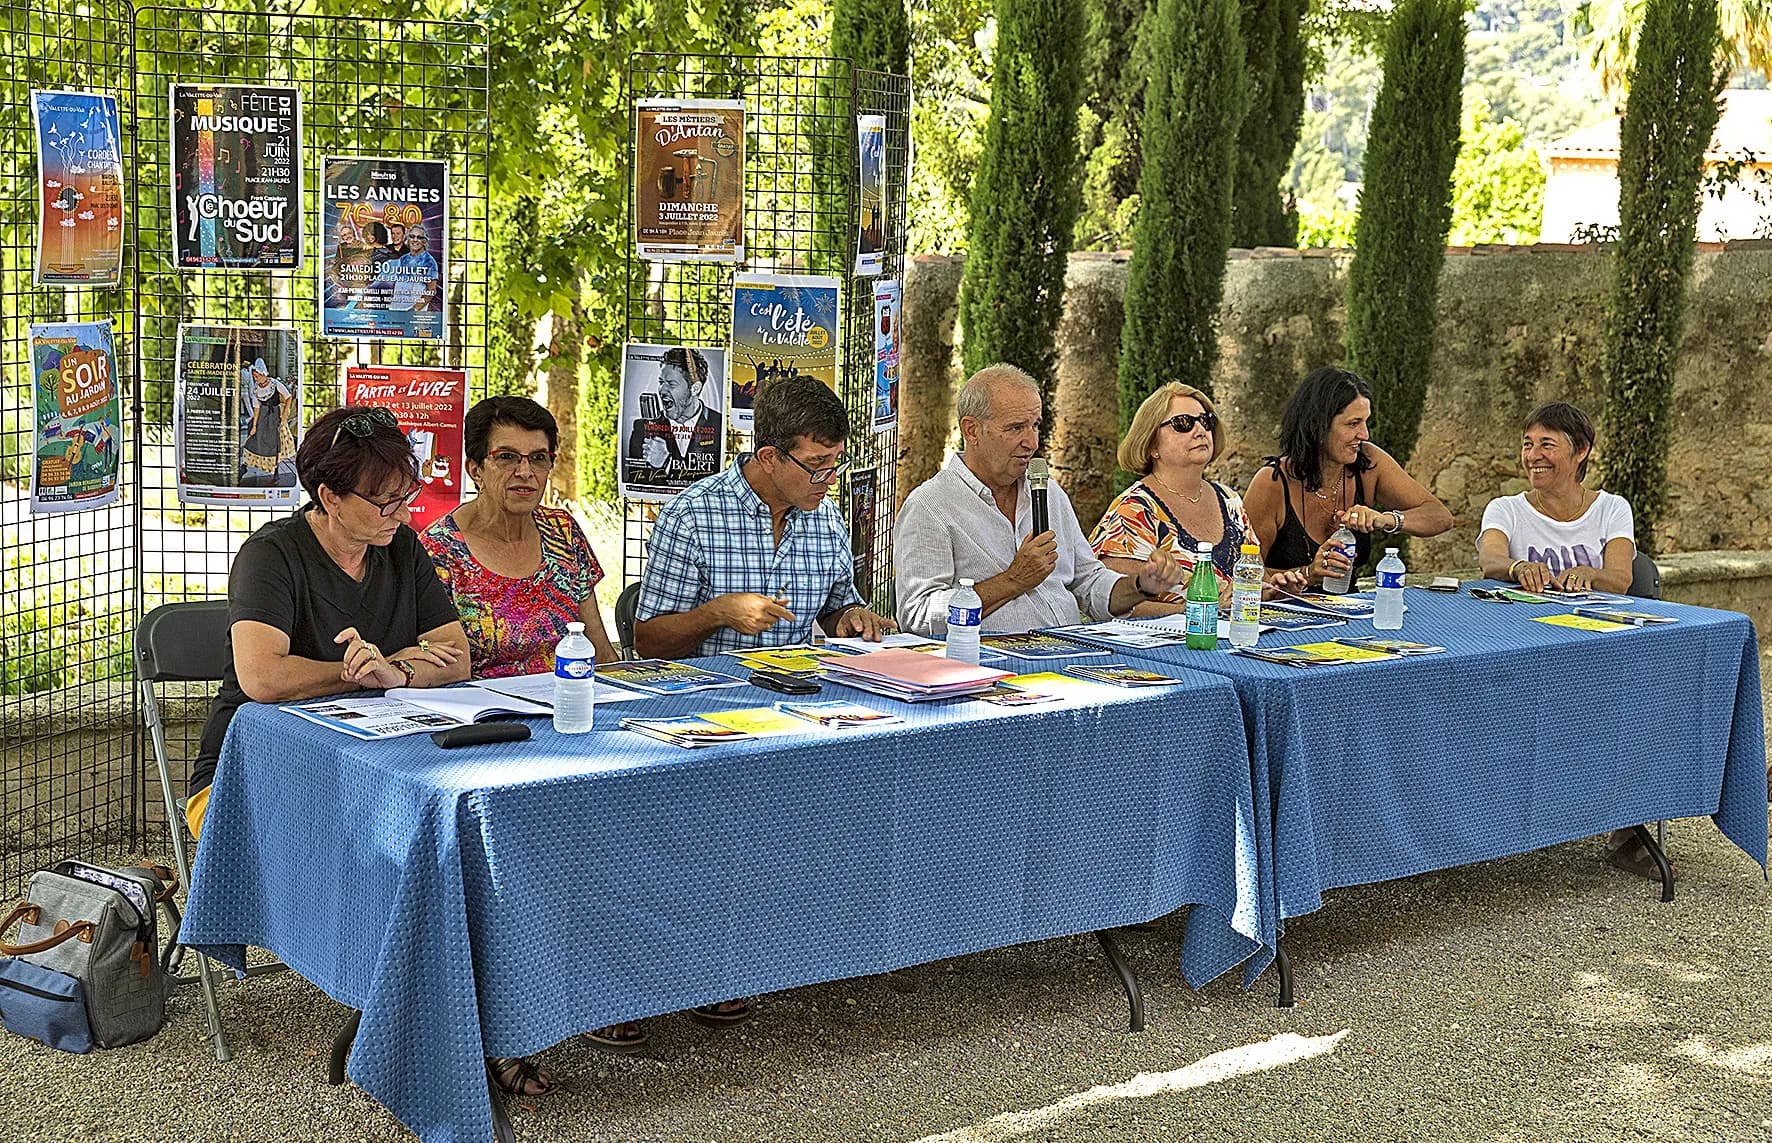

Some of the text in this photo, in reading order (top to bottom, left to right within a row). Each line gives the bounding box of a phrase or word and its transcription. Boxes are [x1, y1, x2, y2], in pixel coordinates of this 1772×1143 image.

[241, 92, 278, 112] FÊTE
[279, 96, 291, 133] DE LA
[680, 115, 716, 124] MÉTIERS
[190, 116, 278, 134] MUSIQUE
[278, 136, 290, 147] 21
[655, 124, 724, 146] D'Antan
[88, 149, 112, 160] CORDES
[262, 146, 290, 158] JUIN
[261, 168, 290, 177] 21H30
[328, 184, 440, 203] LES ANNÉES
[199, 194, 288, 219] Choeur
[206, 200, 214, 212] le
[659, 202, 718, 212] DIMANCHE
[224, 218, 282, 242] du Sud
[340, 262, 428, 275] SAMEDI 30 JUILLET
[751, 303, 816, 332] C'est l'été
[763, 332, 776, 344] La
[777, 330, 810, 347] Valette
[64, 358, 78, 368] UN
[188, 360, 239, 370] CÉLÉBRATION
[62, 353, 108, 394] SOIR
[66, 380, 106, 406] AU JARDIN
[186, 387, 236, 397] 24 JUILLET
[411, 402, 433, 410] juillet
